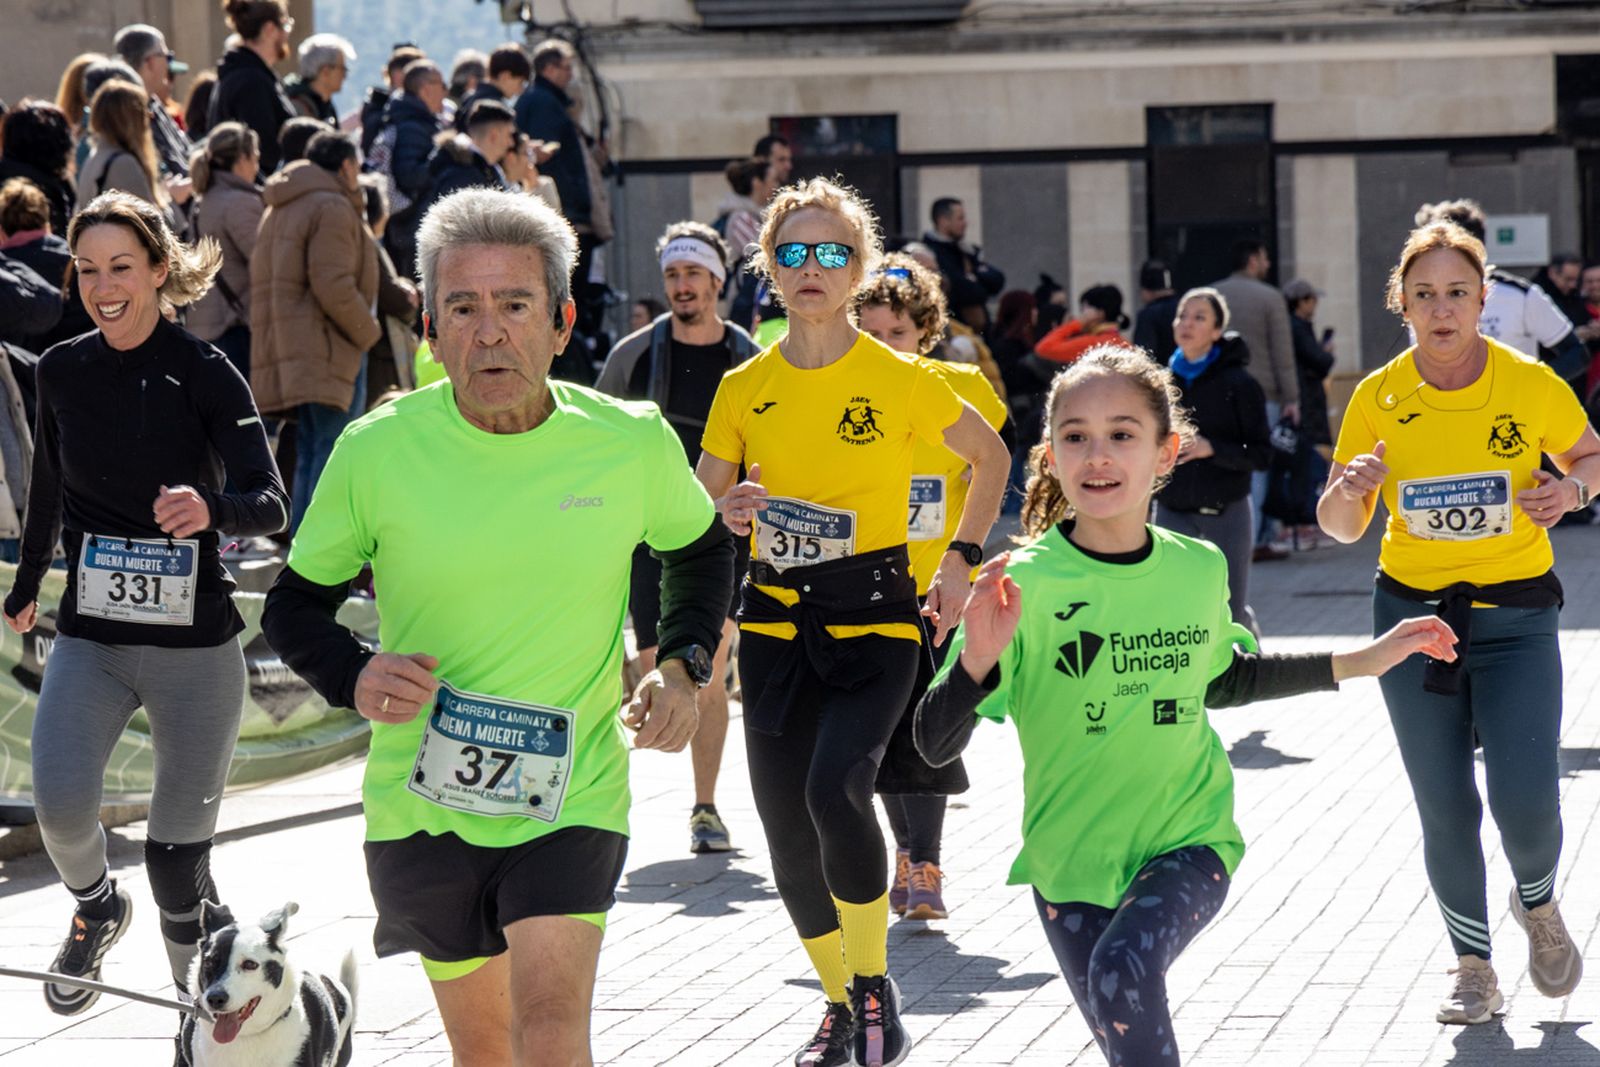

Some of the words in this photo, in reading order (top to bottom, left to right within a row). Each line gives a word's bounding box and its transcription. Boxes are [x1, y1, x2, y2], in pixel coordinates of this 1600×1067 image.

[840, 434, 876, 446] ENTRENA
[1423, 483, 1457, 494] CARRERA
[1457, 479, 1496, 490] CAMINATA
[574, 495, 604, 508] asics
[1414, 495, 1442, 507] BUENA
[1444, 491, 1479, 505] MUERTE
[786, 517, 822, 535] MUERTE
[800, 510, 840, 523] CAMINATA
[1427, 506, 1487, 532] 302
[106, 542, 140, 554] CARRRA
[770, 530, 821, 560] 315
[94, 552, 123, 569] BUENA
[125, 556, 163, 572] MUERTE
[107, 571, 161, 605] 331
[1109, 624, 1210, 653] Fundación
[1112, 649, 1190, 675] Unicaja
[1112, 681, 1149, 697] Jaén
[449, 699, 497, 720] CARRERA
[499, 710, 553, 729] CAMINATA
[475, 722, 526, 748] MUERTE
[455, 744, 519, 790] 37
